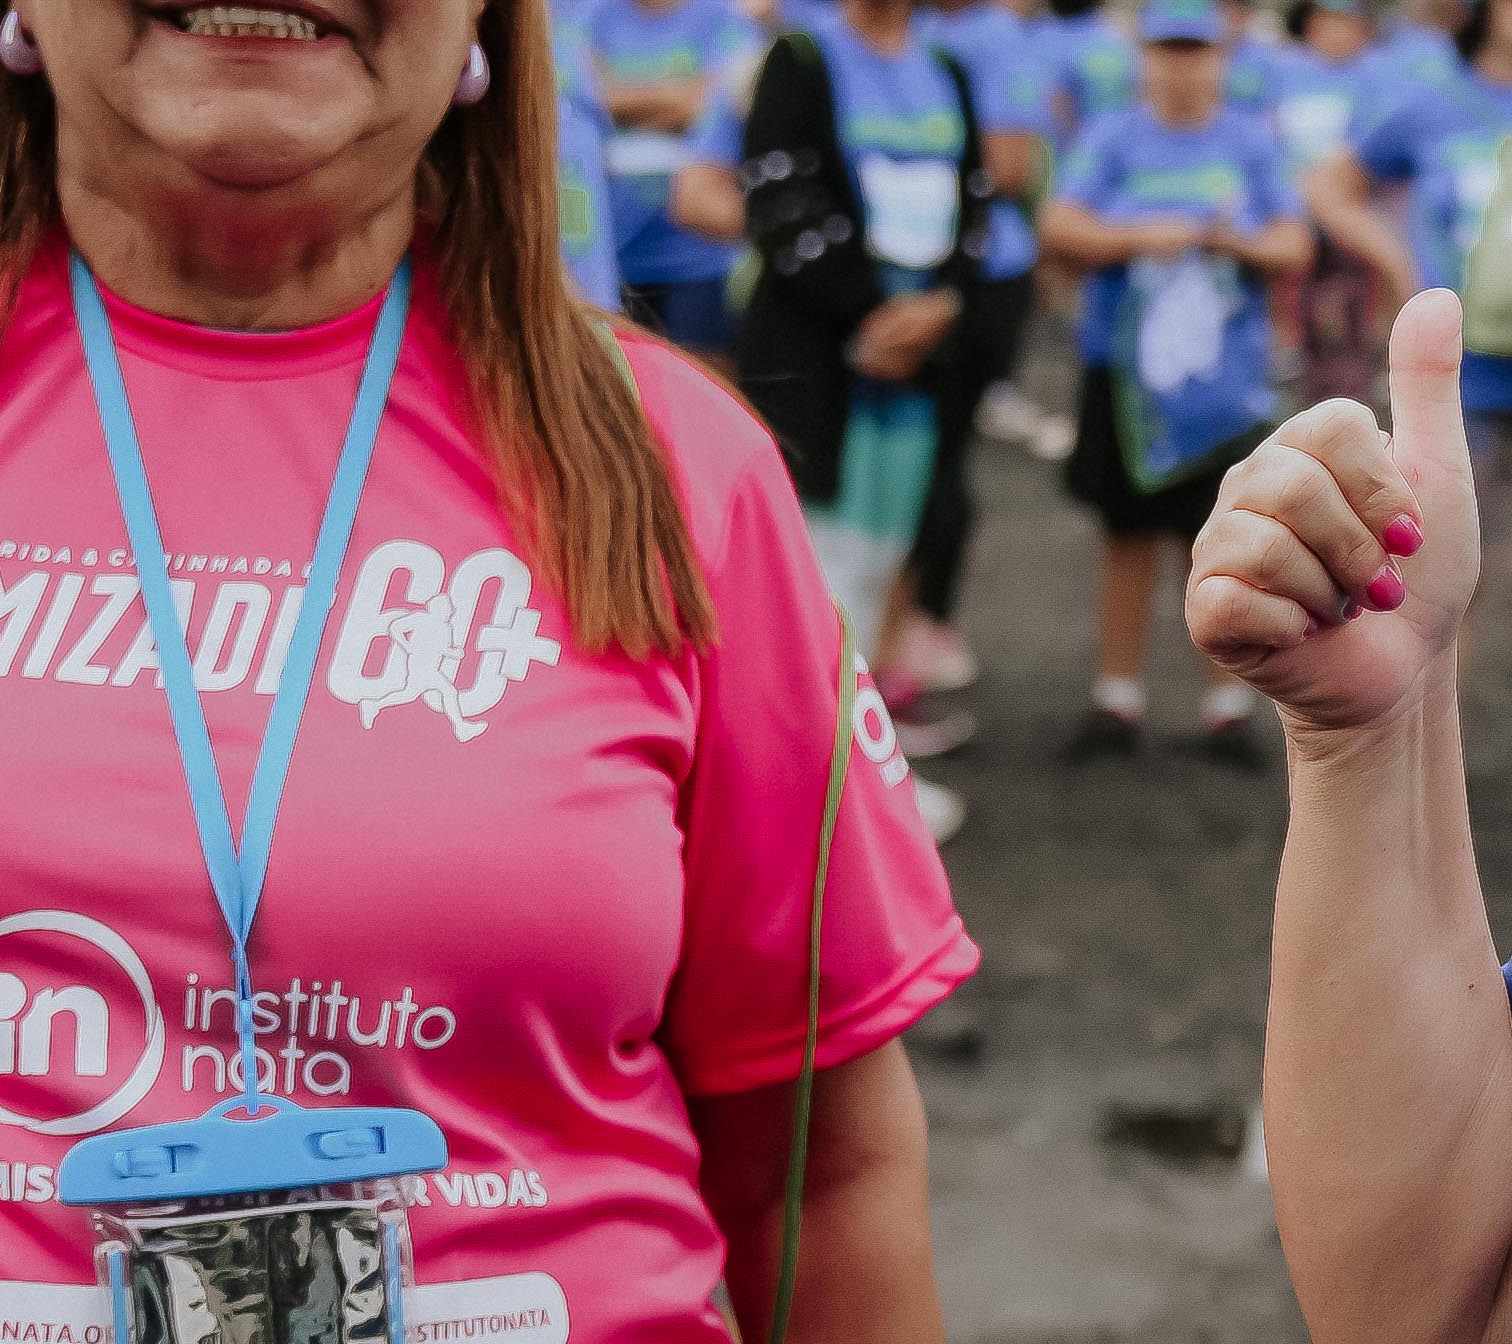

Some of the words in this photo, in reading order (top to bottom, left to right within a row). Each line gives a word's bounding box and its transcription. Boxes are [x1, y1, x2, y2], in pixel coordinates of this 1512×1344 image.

[107, 546, 292, 578] CINHADA
[326, 538, 562, 731] 60+
[184, 972, 458, 1051] instituto
[181, 1034, 352, 1096] nata
[432, 1168, 549, 1208] VIDAS
